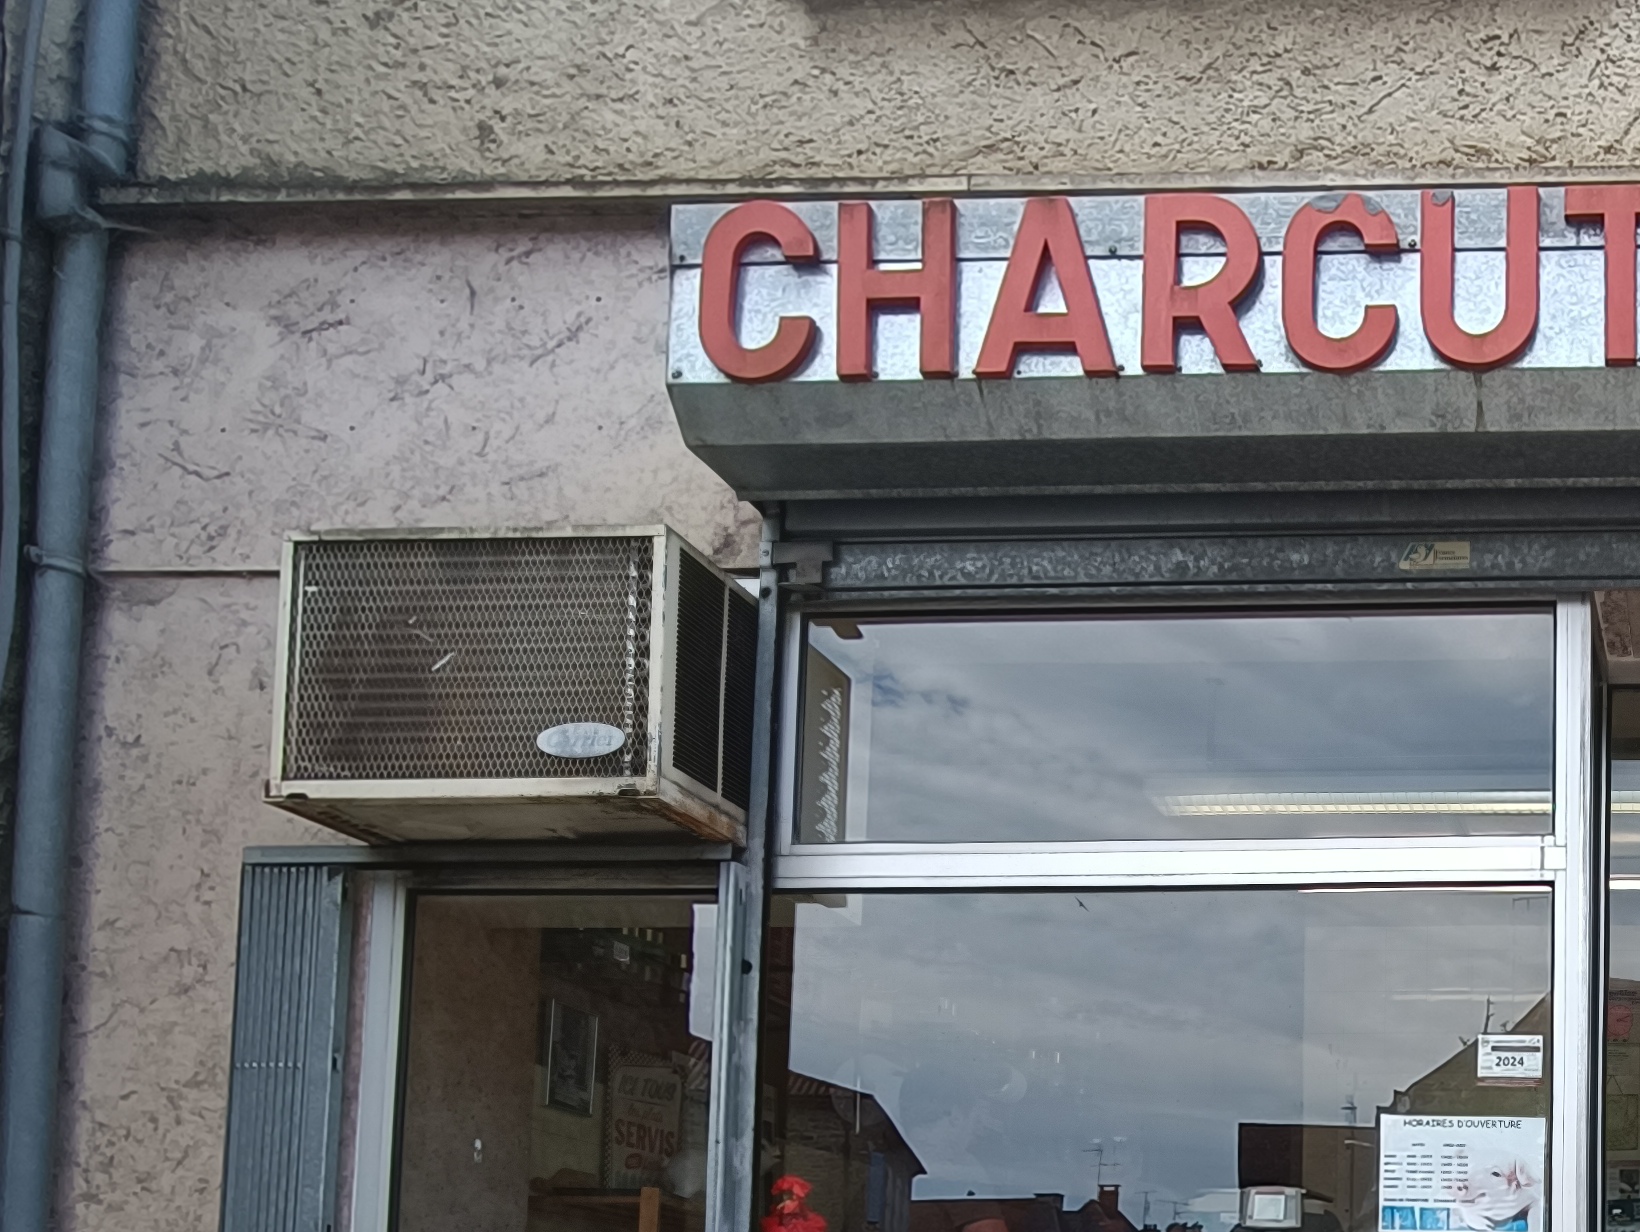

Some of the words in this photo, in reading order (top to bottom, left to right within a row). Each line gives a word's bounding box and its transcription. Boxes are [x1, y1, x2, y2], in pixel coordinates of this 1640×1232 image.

[1495, 1055, 1525, 1068] 2024
[1403, 1118, 1455, 1129] HORAIRES
[1457, 1119, 1523, 1130] D'OUVERTURE
[614, 1118, 676, 1158] SERVIS
